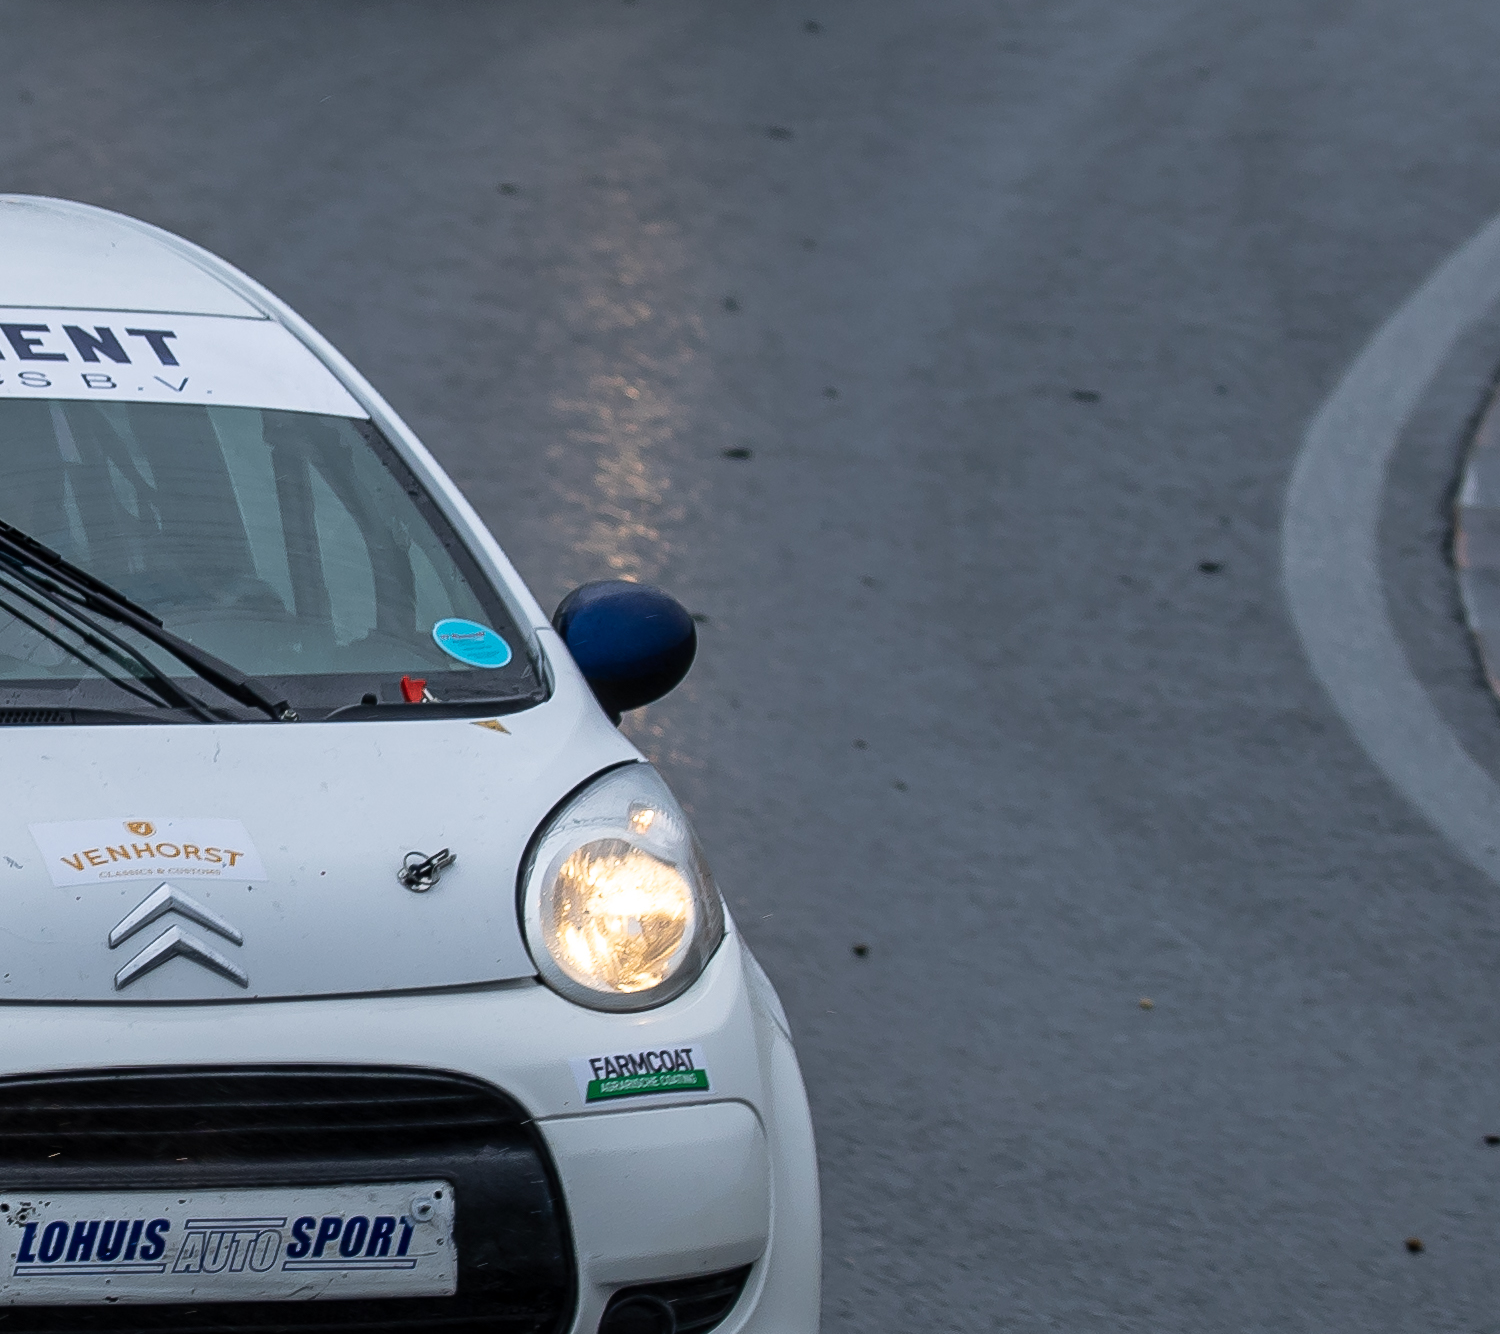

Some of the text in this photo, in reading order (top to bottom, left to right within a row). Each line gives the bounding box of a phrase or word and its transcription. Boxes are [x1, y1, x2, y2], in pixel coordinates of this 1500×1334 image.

[81, 372, 213, 395] B.V.
[60, 842, 244, 872] VENHORST
[589, 1048, 693, 1080] FARMCOAT
[16, 1215, 415, 1274] LOHUIS AUTO SPORT
